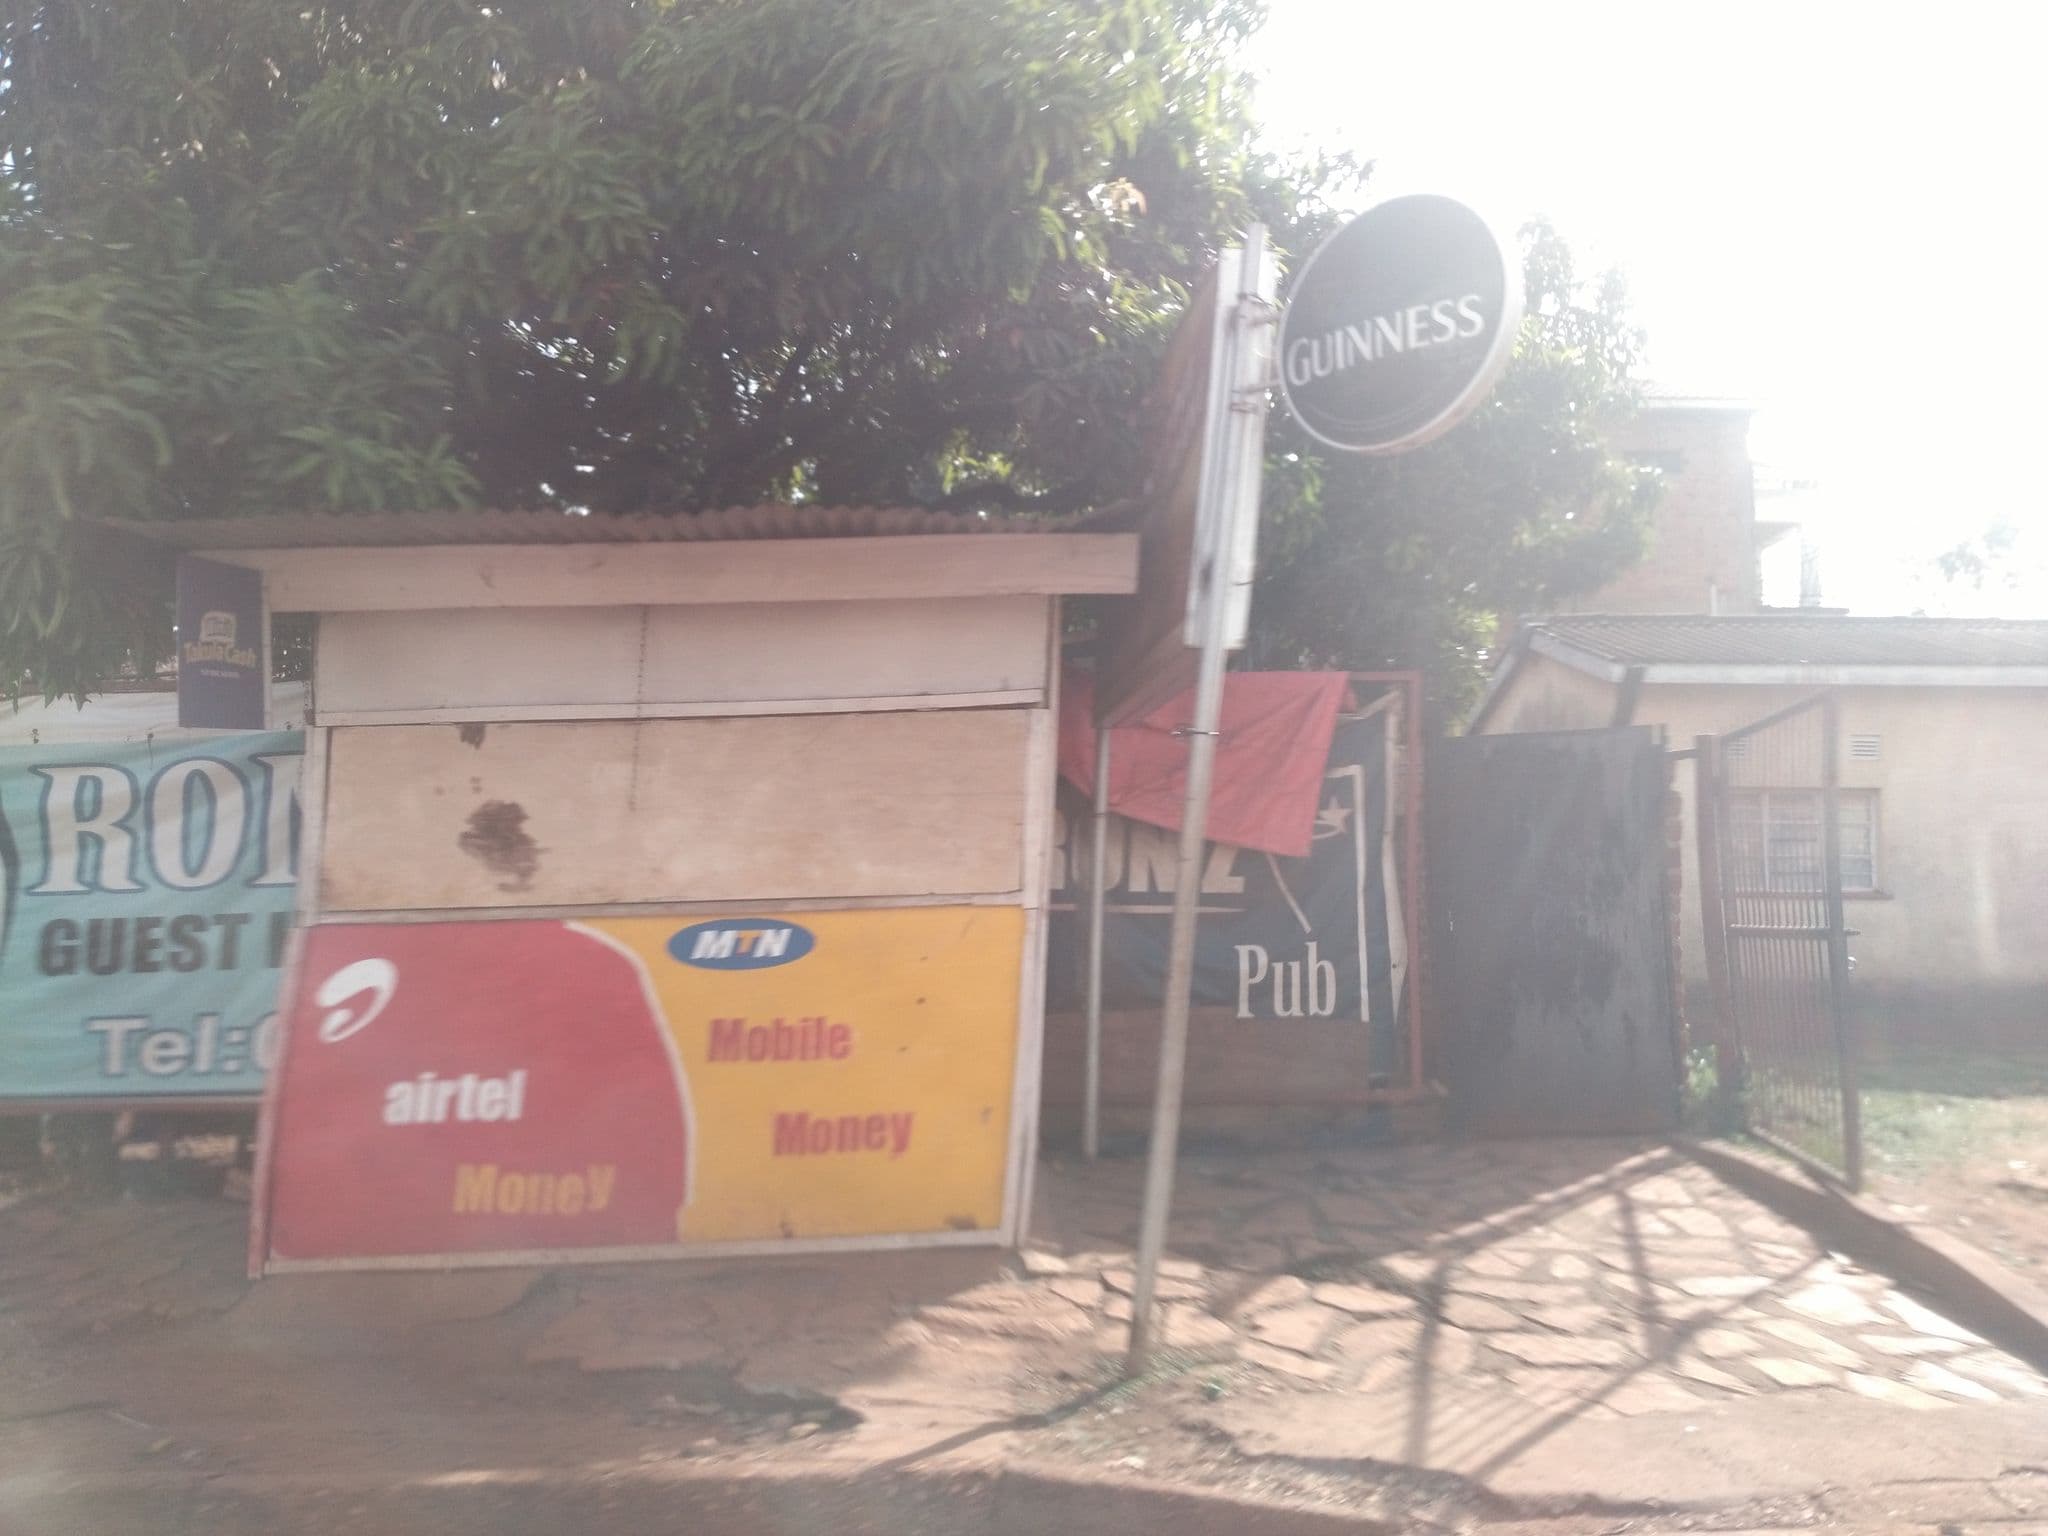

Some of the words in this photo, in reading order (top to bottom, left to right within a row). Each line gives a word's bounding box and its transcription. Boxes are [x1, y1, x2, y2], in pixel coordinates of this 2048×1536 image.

[1286, 294, 1486, 386] GUINNESS
[39, 912, 252, 977] GUEST
[690, 928, 793, 959] MTN
[1234, 941, 1337, 1019] Pub
[708, 1016, 852, 1063] Mobile
[384, 1068, 528, 1125] airtel
[772, 1111, 914, 1160] Money
[453, 1162, 616, 1215] Money
